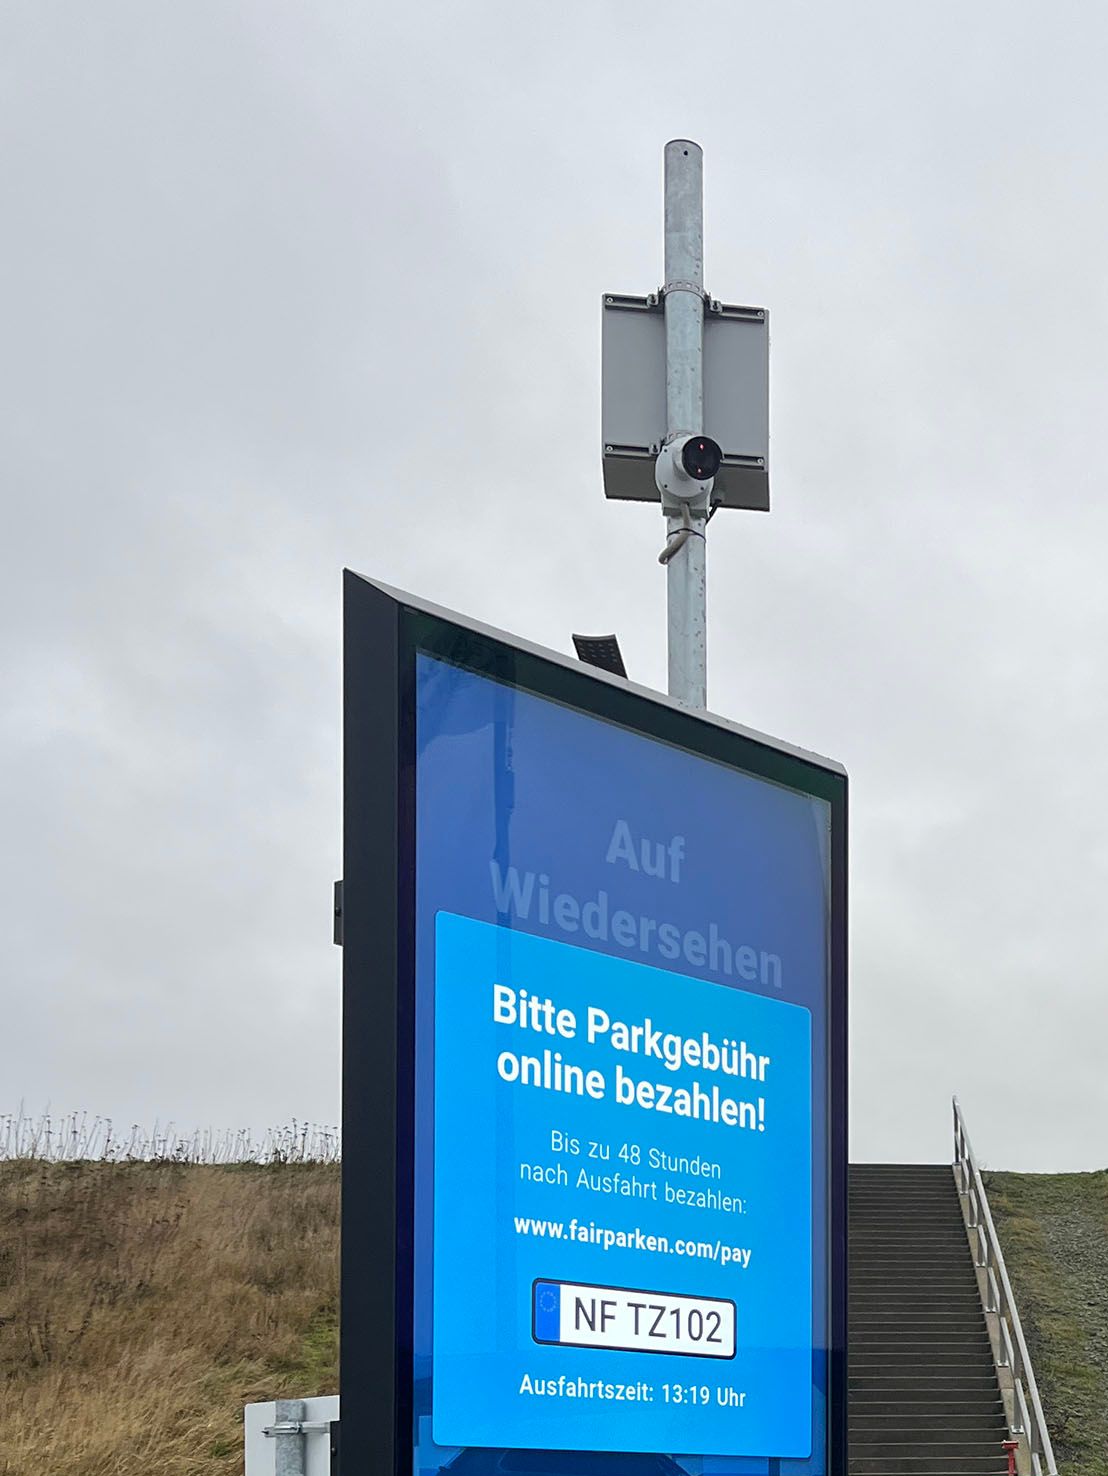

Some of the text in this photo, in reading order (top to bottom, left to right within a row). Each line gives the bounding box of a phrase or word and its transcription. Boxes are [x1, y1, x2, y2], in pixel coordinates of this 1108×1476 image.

[606, 819, 685, 883] Auf
[489, 859, 782, 989] Wiedersehen
[493, 983, 770, 1082] Bitte Parkgebühr
[497, 1049, 766, 1132] online bezahlen!
[551, 1130, 721, 1179] Bis zu 48 Stunden
[520, 1163, 747, 1214] nach Ausfahrt bezahlen:
[514, 1217, 752, 1268] www.fairparken.com/pay
[574, 1297, 722, 1343] NF TZ102
[520, 1374, 746, 1407] Ausfahrtszeit: 13:19 Uhr
